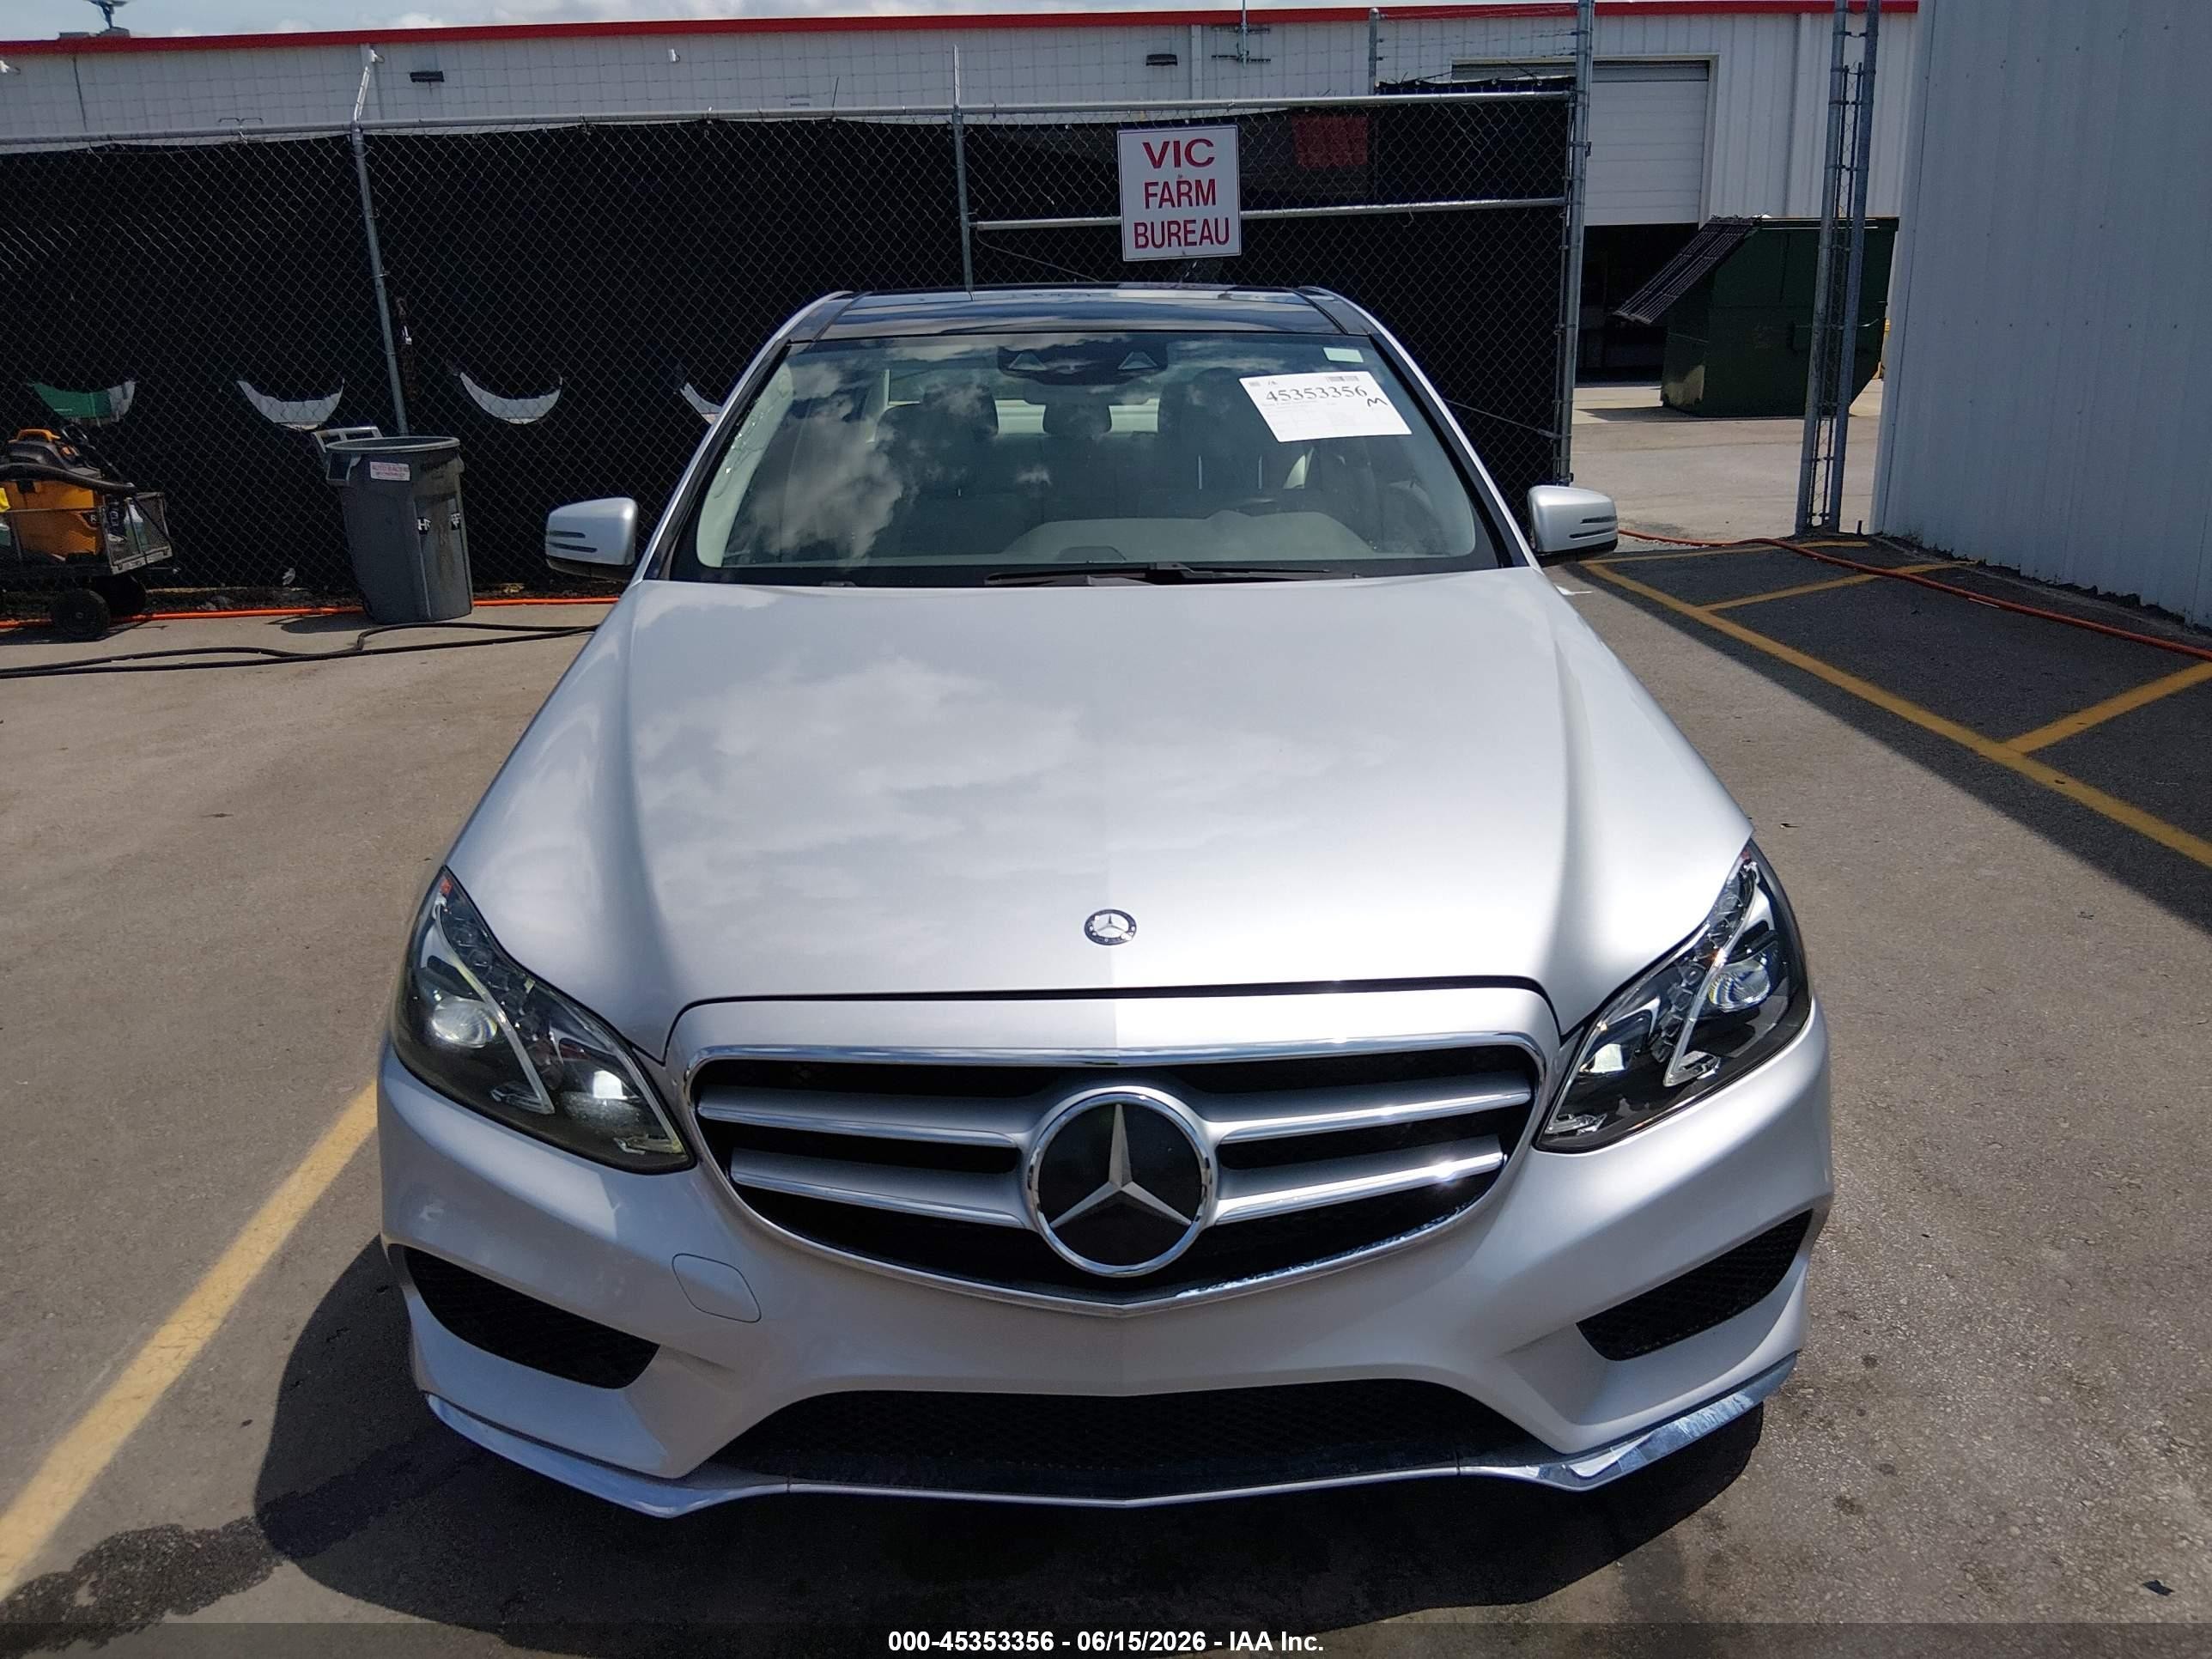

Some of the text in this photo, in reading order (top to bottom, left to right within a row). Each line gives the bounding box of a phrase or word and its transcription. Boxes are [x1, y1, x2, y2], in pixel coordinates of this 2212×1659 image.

[1142, 138, 1215, 169] VIC
[1144, 179, 1216, 210] FARM
[1133, 217, 1230, 249] BUREAU
[1266, 386, 1368, 403] 45353356
